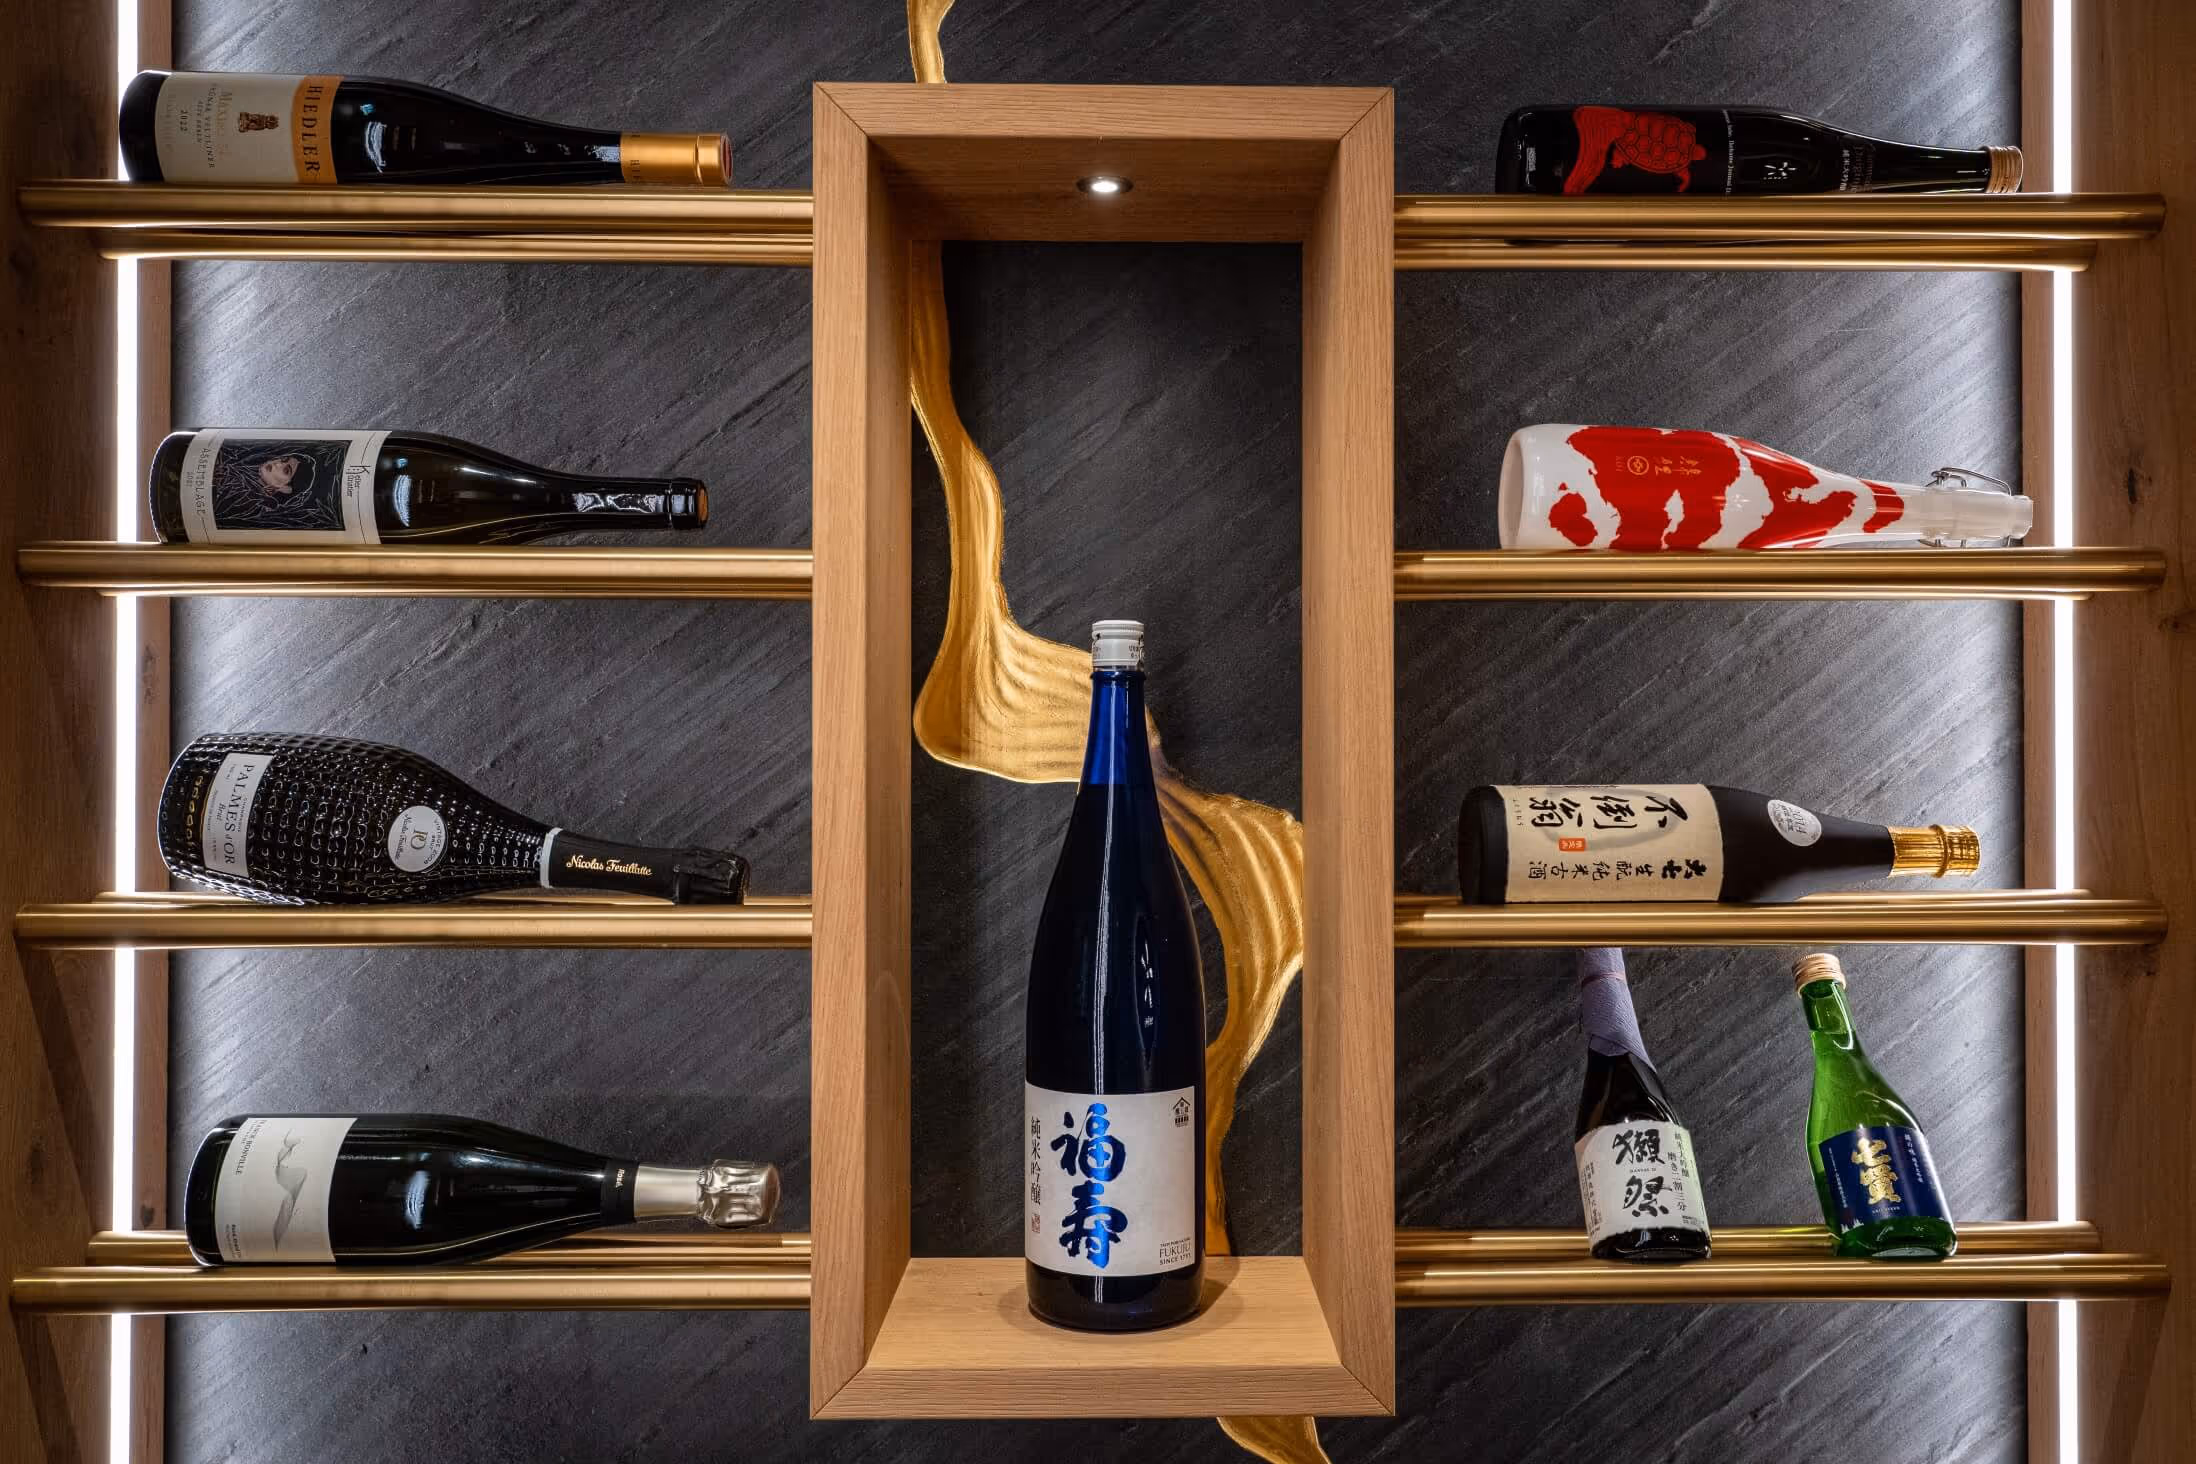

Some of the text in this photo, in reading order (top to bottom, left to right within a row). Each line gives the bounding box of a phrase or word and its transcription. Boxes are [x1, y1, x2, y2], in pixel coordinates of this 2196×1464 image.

[302, 85, 324, 173] HIEDLER
[195, 447, 211, 515] ASSEMBLAGE
[224, 764, 255, 832] PALMES
[566, 854, 656, 877] Nicolas Feuillatte
[1050, 1102, 1129, 1270] 福寿
[1850, 1137, 1902, 1205] 七賢
[1159, 1240, 1191, 1259] FUKUJU
[1159, 1256, 1178, 1266] SINCE
